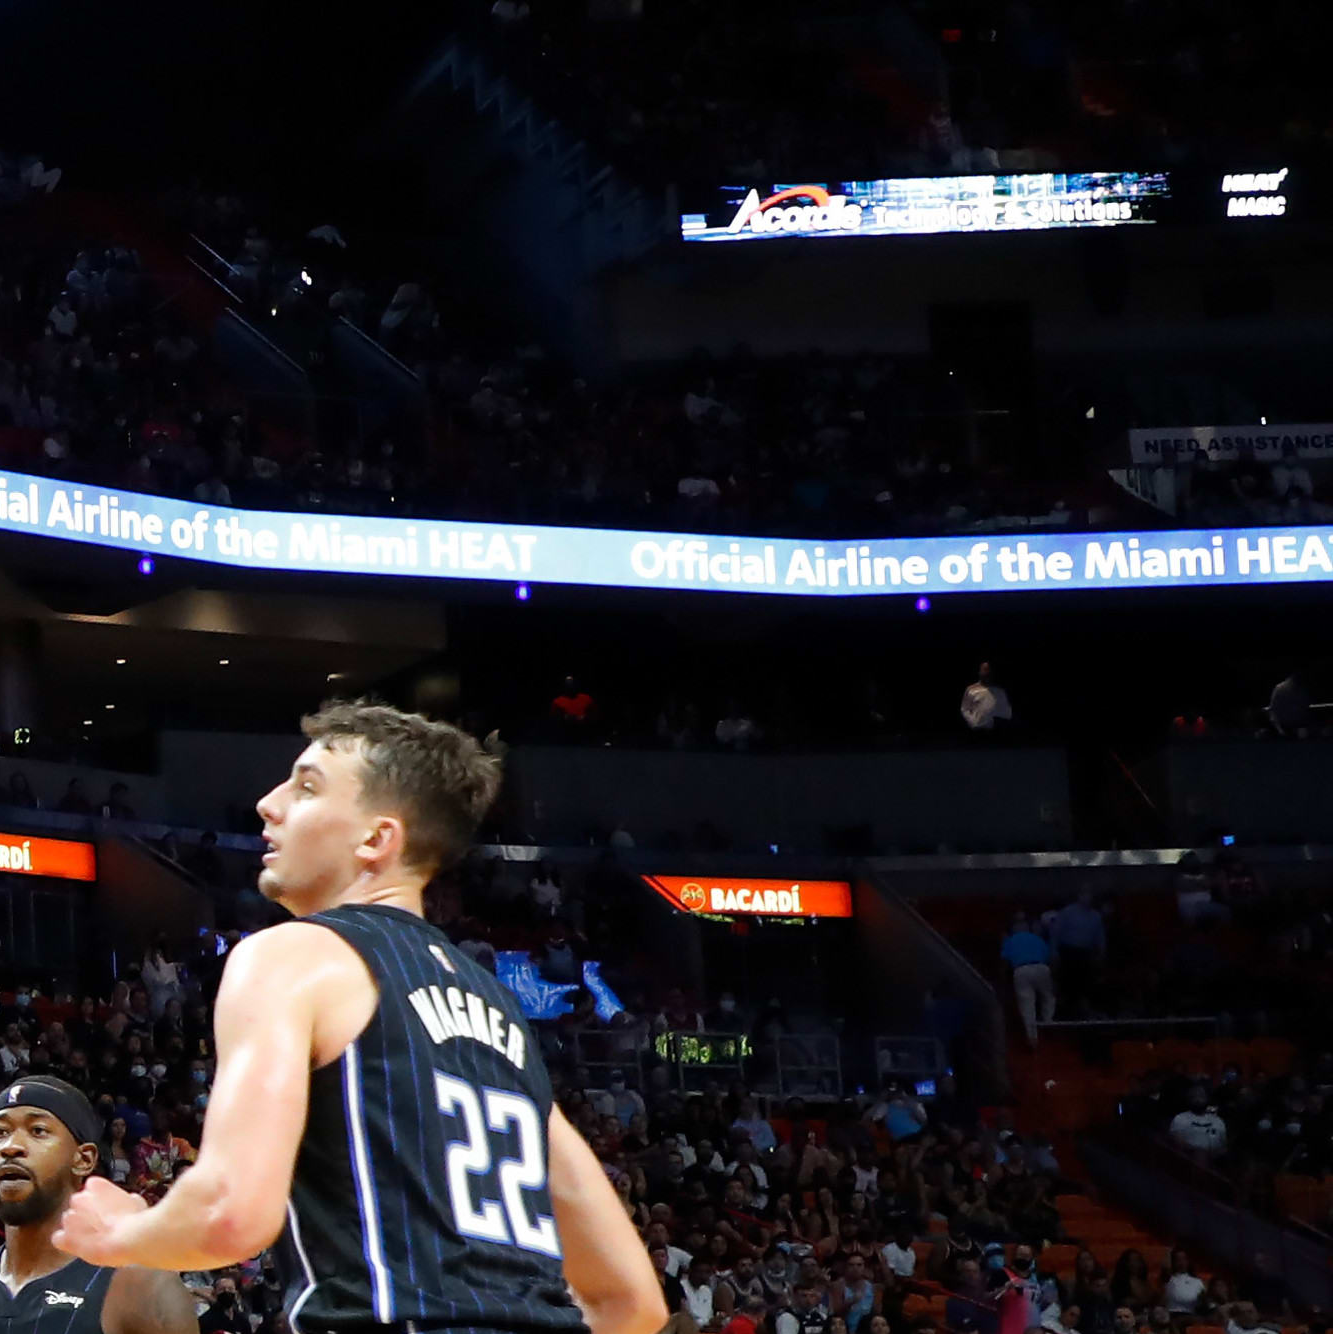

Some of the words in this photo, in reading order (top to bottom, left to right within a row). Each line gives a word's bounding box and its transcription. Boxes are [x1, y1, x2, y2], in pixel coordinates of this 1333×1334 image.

[1027, 200, 1132, 224] Solutions
[47, 489, 163, 546] Airline
[171, 511, 209, 551] of
[217, 517, 277, 560] the
[289, 523, 417, 568] Miami
[428, 528, 538, 574] HEAT
[630, 540, 776, 586] Official
[784, 548, 929, 588] Airline
[939, 543, 990, 585] of
[996, 542, 1074, 583] the
[1085, 535, 1226, 580] Miami
[710, 884, 804, 914] BACARDÍ
[408, 985, 525, 1069] WAGNER
[432, 1065, 564, 1260] 22
